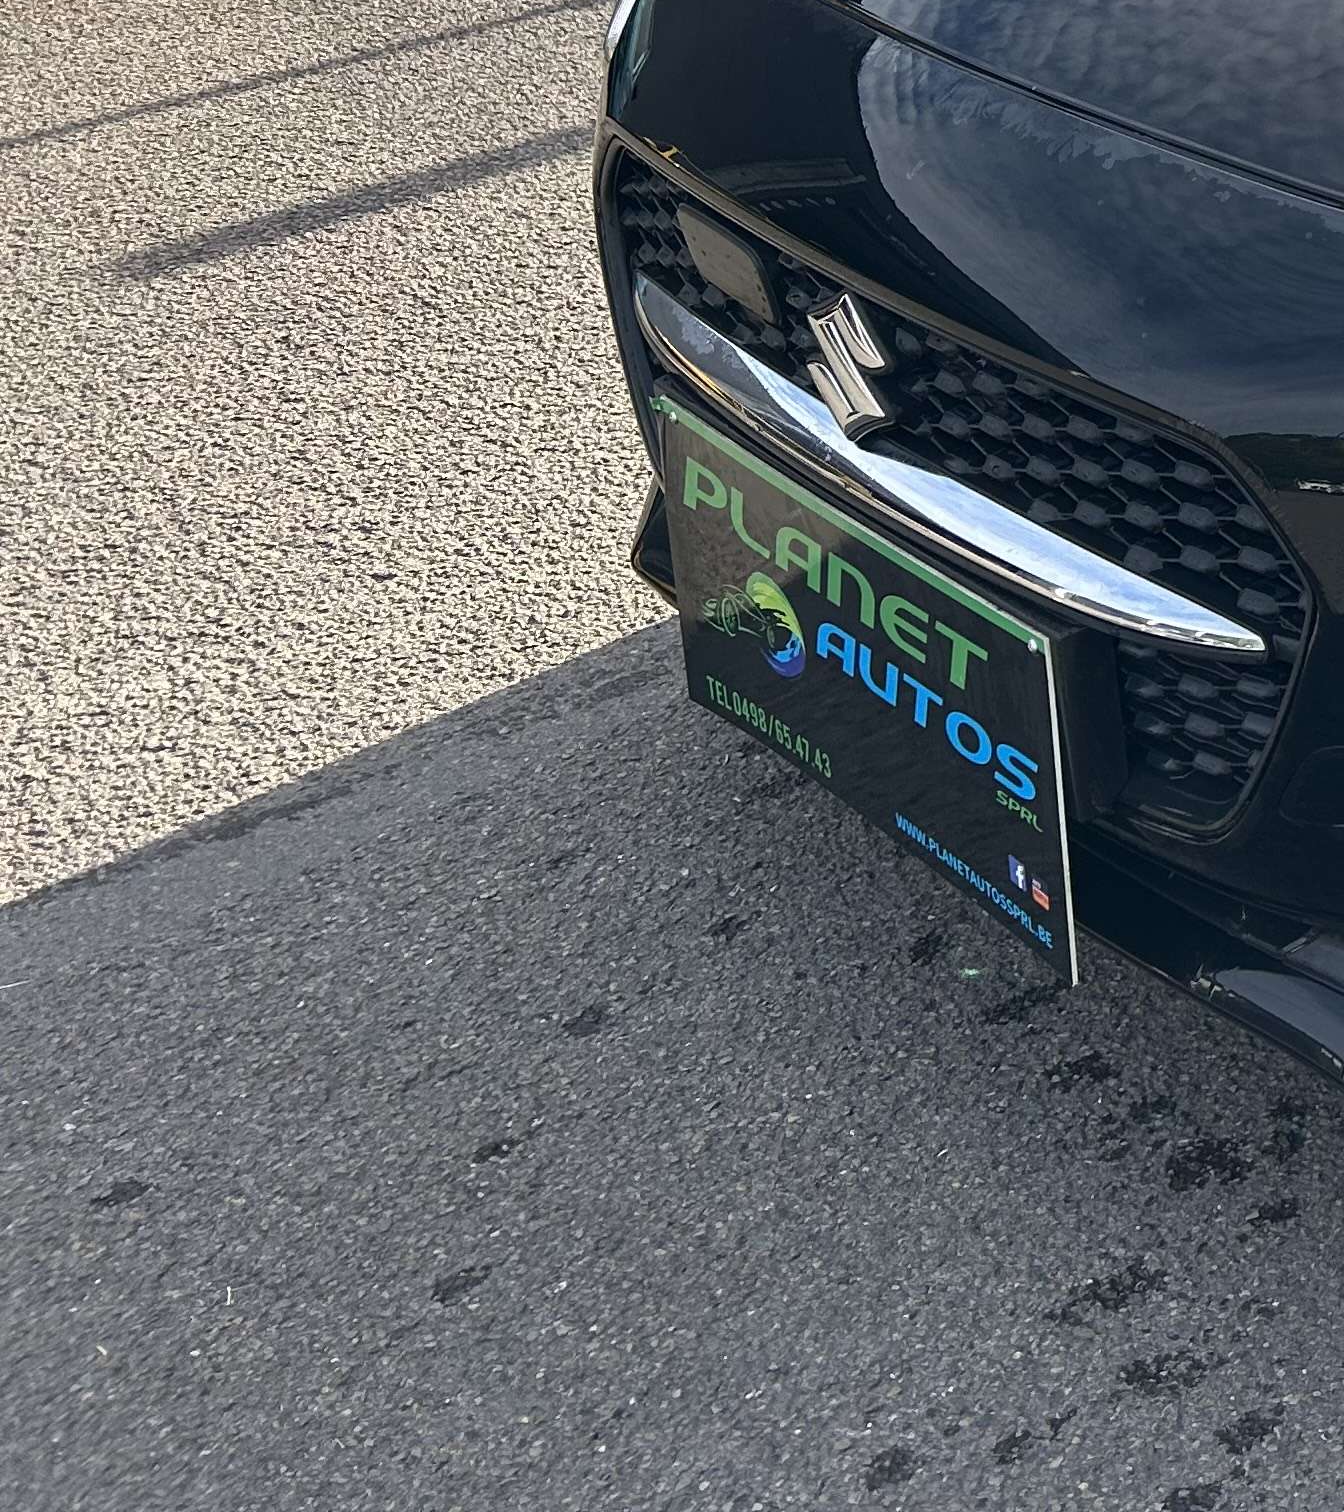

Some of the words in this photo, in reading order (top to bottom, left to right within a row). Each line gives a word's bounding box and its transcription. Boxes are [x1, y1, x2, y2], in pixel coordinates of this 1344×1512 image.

[682, 456, 989, 690] PLANET
[706, 674, 732, 711] TEL
[732, 691, 832, 779] 0498/65.47.43
[816, 621, 1040, 802] AUTOS
[995, 789, 1044, 833] SPRL
[895, 812, 1054, 950] WWW.PLANETAUTOSSPRL.BE
